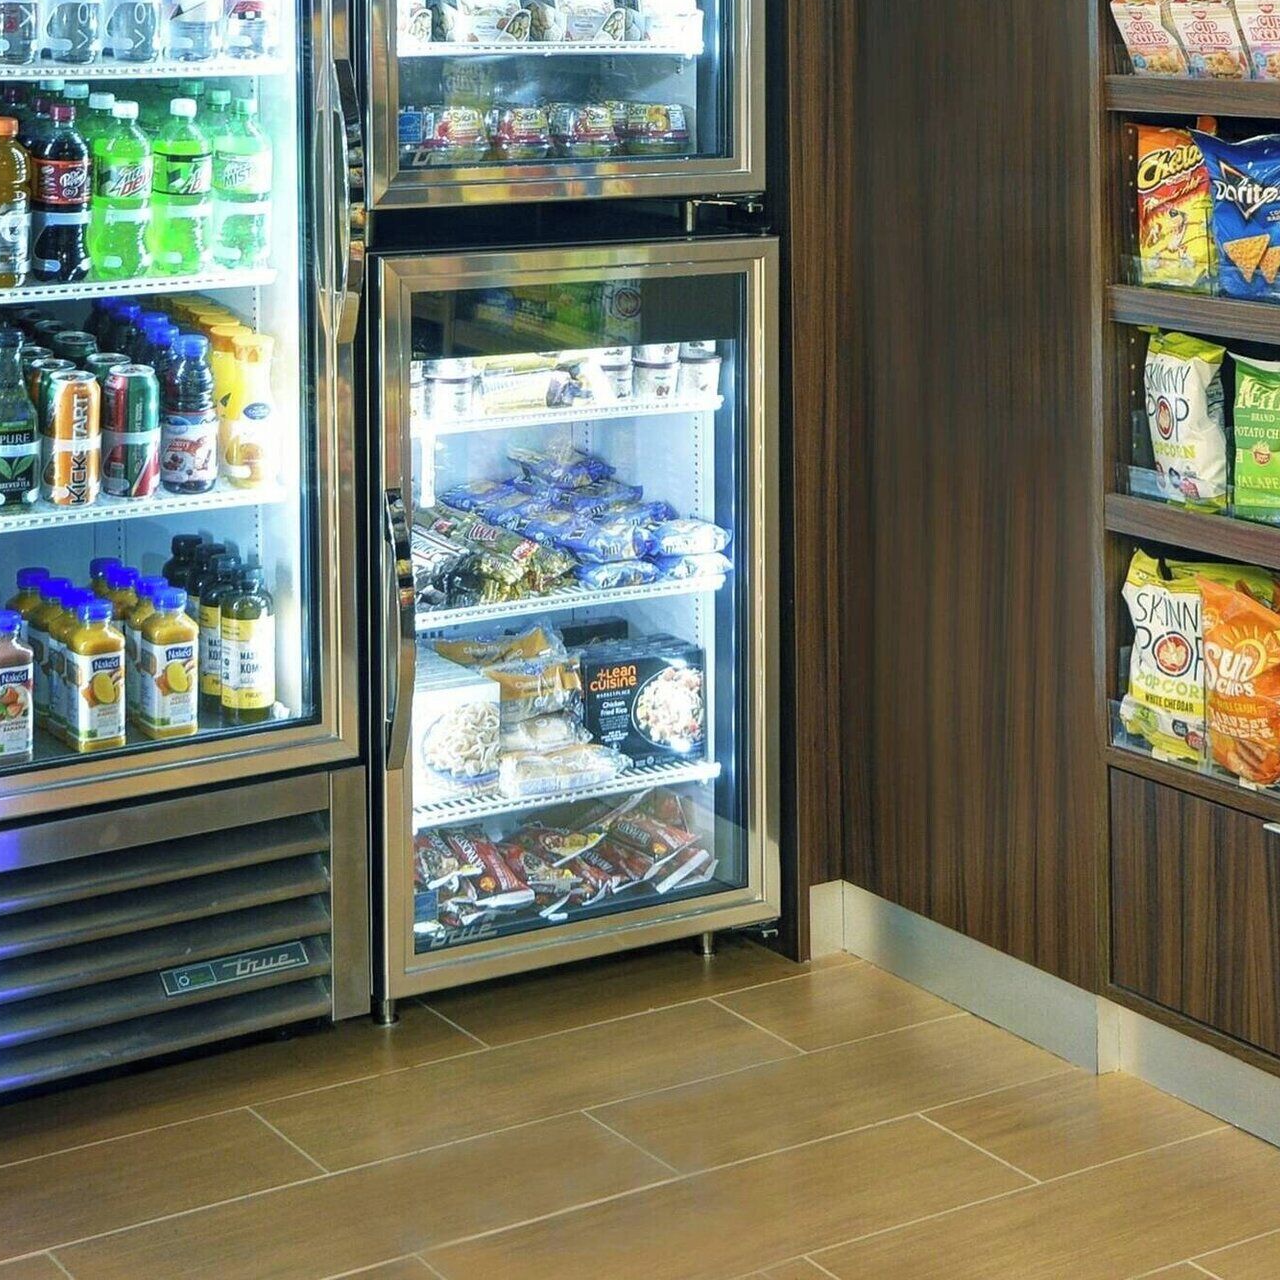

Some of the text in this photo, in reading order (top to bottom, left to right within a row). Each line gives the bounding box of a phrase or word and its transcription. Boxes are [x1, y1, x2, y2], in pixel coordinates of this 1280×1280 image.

[1130, 20, 1154, 34] CUP
[1192, 20, 1218, 34] CUP
[1125, 31, 1169, 46] NOODLES
[1186, 31, 1232, 46] NOODLES
[1250, 413, 1275, 423] BRAND
[0, 433, 30, 444] PURE
[71, 394, 89, 504] KICKSTART
[168, 647, 193, 659] Naked
[93, 657, 119, 671] Naked
[605, 664, 636, 678] Lean
[1204, 641, 1255, 691] Sun
[1, 671, 28, 684] Naked
[1216, 677, 1257, 697] CHIPS
[602, 700, 626, 709] Chicken
[1145, 692, 1195, 713] WHITE CHEDDAR
[600, 706, 628, 716] Fried Rice
